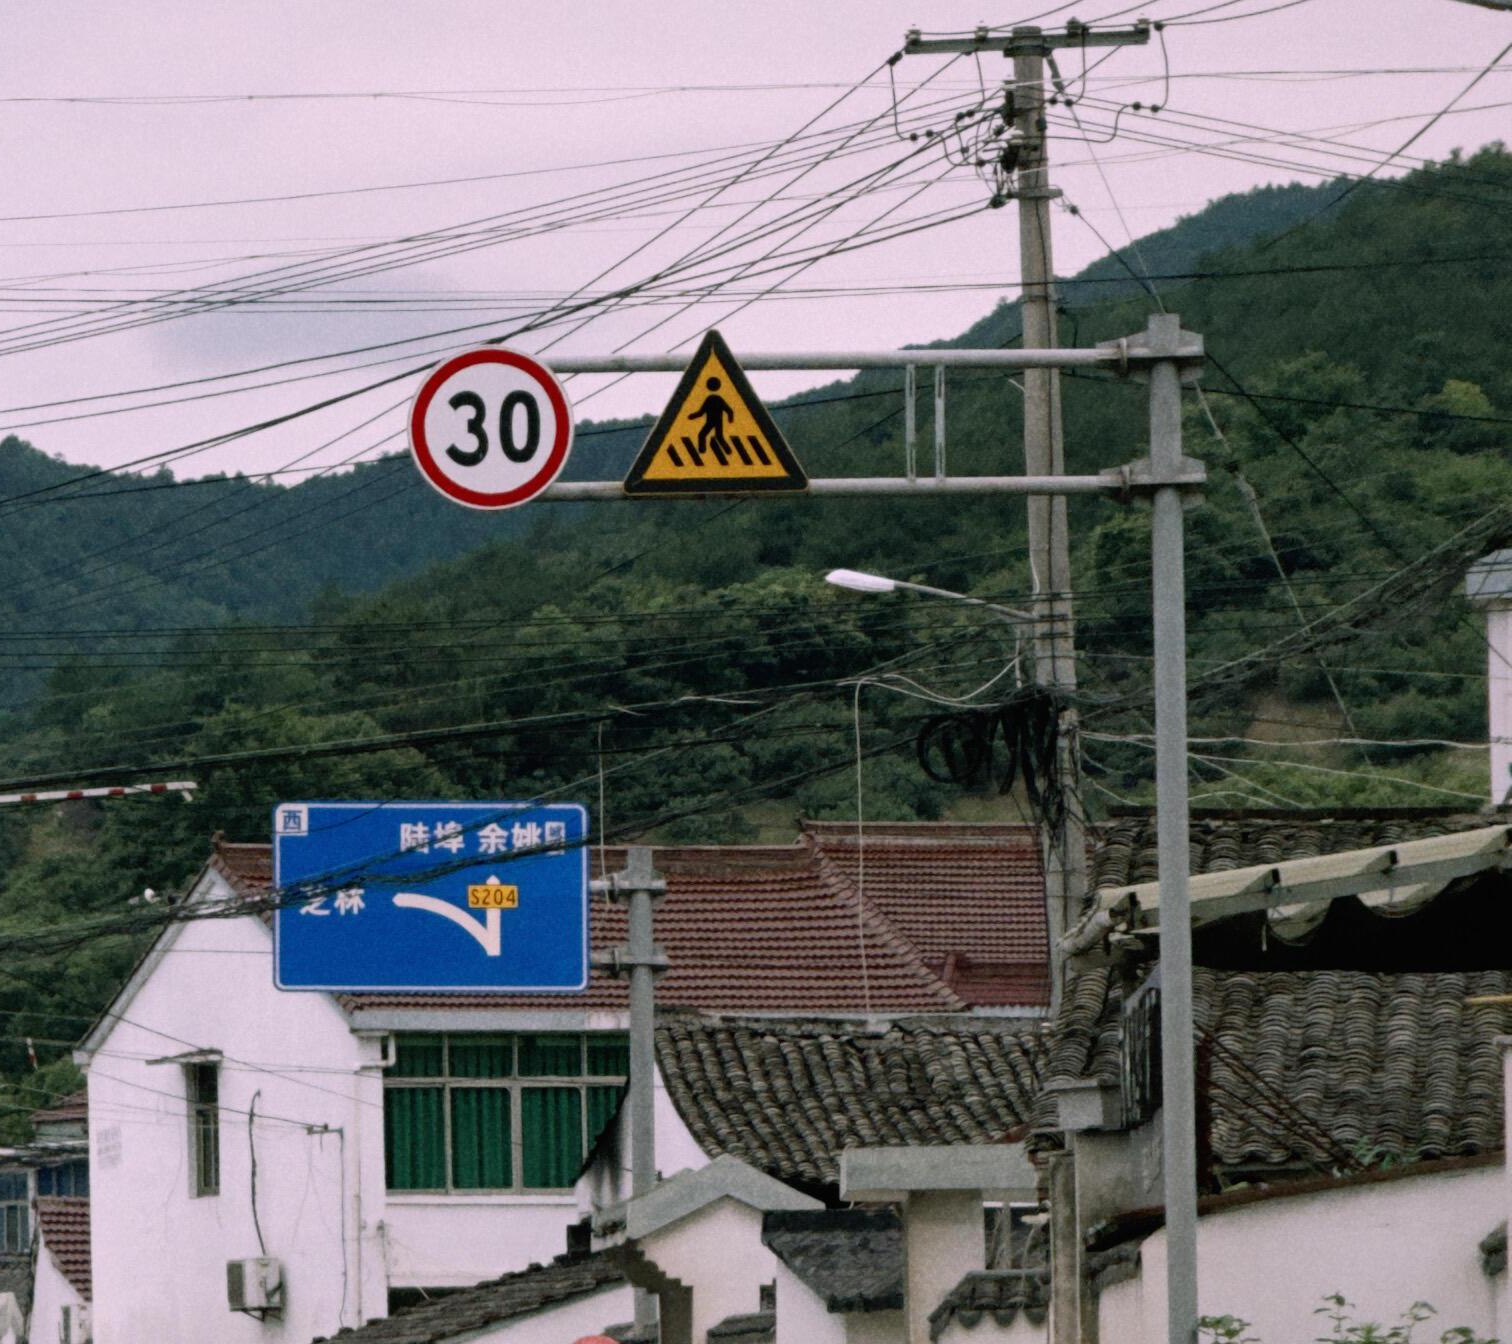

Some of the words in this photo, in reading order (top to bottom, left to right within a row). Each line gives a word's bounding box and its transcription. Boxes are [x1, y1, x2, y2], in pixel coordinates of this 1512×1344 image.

[444, 390, 541, 467] 30
[281, 809, 303, 832] 西
[399, 821, 465, 854] 陆埠
[477, 821, 542, 854] 余姚
[470, 888, 516, 906] S204
